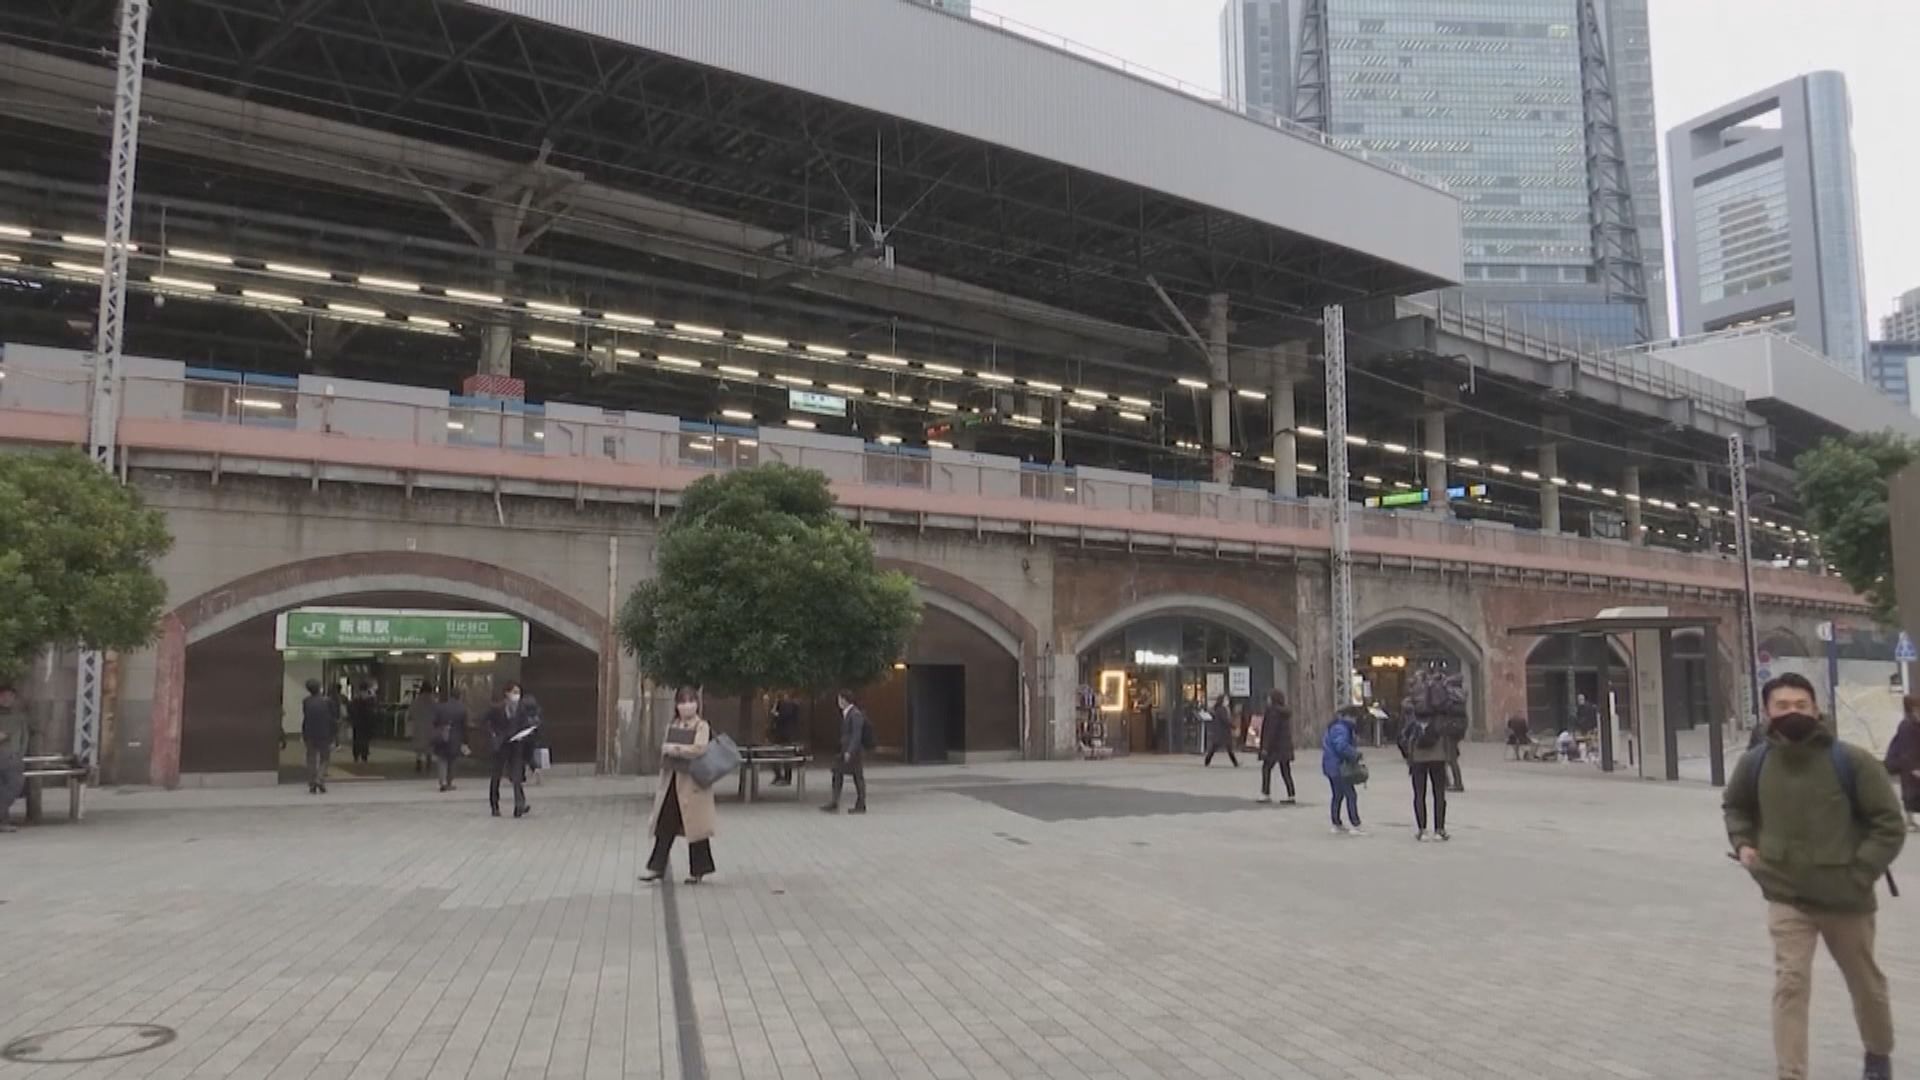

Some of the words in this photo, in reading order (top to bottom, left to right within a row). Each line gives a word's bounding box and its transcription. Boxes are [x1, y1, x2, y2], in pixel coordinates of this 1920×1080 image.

[303, 621, 325, 635] JR
[338, 619, 390, 634] 新橋駅
[393, 636, 427, 645] Station
